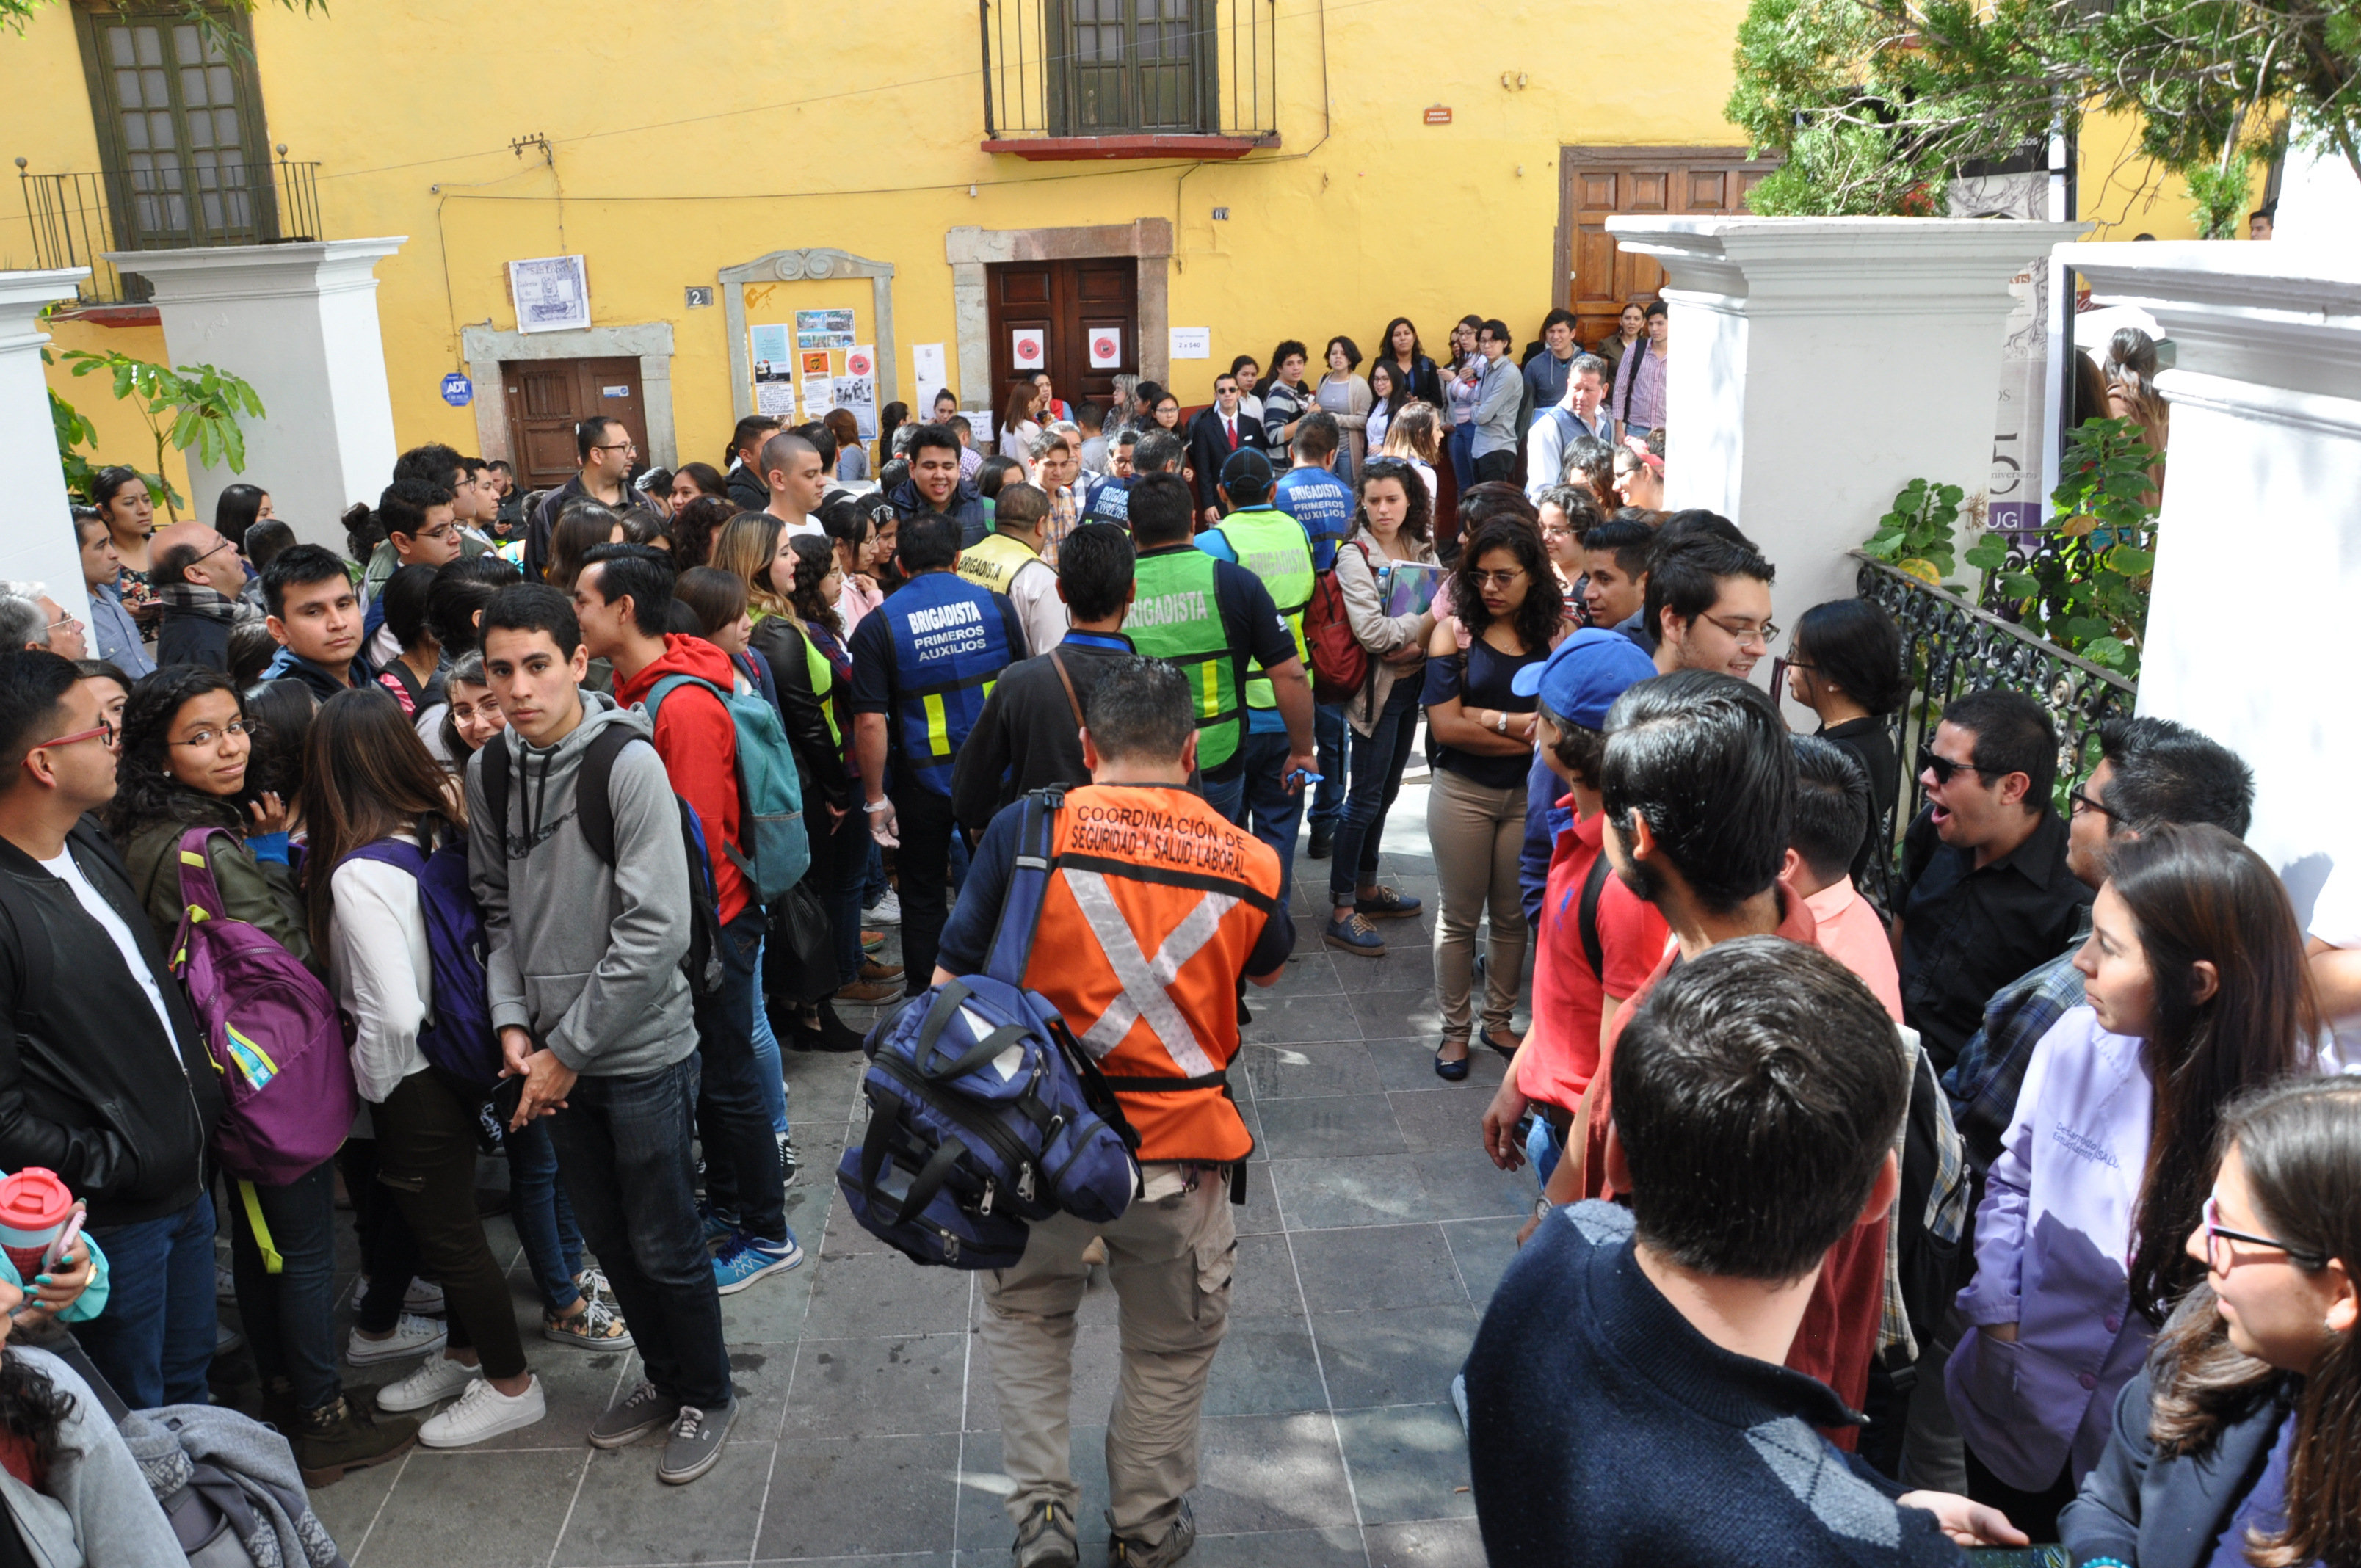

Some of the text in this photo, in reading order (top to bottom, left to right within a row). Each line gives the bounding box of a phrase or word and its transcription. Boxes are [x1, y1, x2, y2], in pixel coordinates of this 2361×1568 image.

[692, 291, 703, 305] 2
[446, 381, 466, 393] ADT
[1991, 469, 2037, 479] niversario
[1288, 484, 1343, 501] BRIGADISTA
[1294, 501, 1345, 512] PRIMEROS
[1296, 509, 1346, 520] AUXILIOS
[957, 556, 1004, 581] BRIGADISTA
[1249, 548, 1309, 578] BRIGADISTA
[907, 600, 982, 635] BRIGADISTA
[914, 625, 985, 650] PRIMEROS
[918, 638, 987, 662] AUXILIOS
[1078, 805, 1246, 851] COORDINACIÓN DE
[1071, 824, 1246, 879] SEGURIDAD Y SALUD LABORAL
[2053, 1132, 2093, 1161] Estudiantil
[2056, 1122, 2097, 1150] Desarrollo
